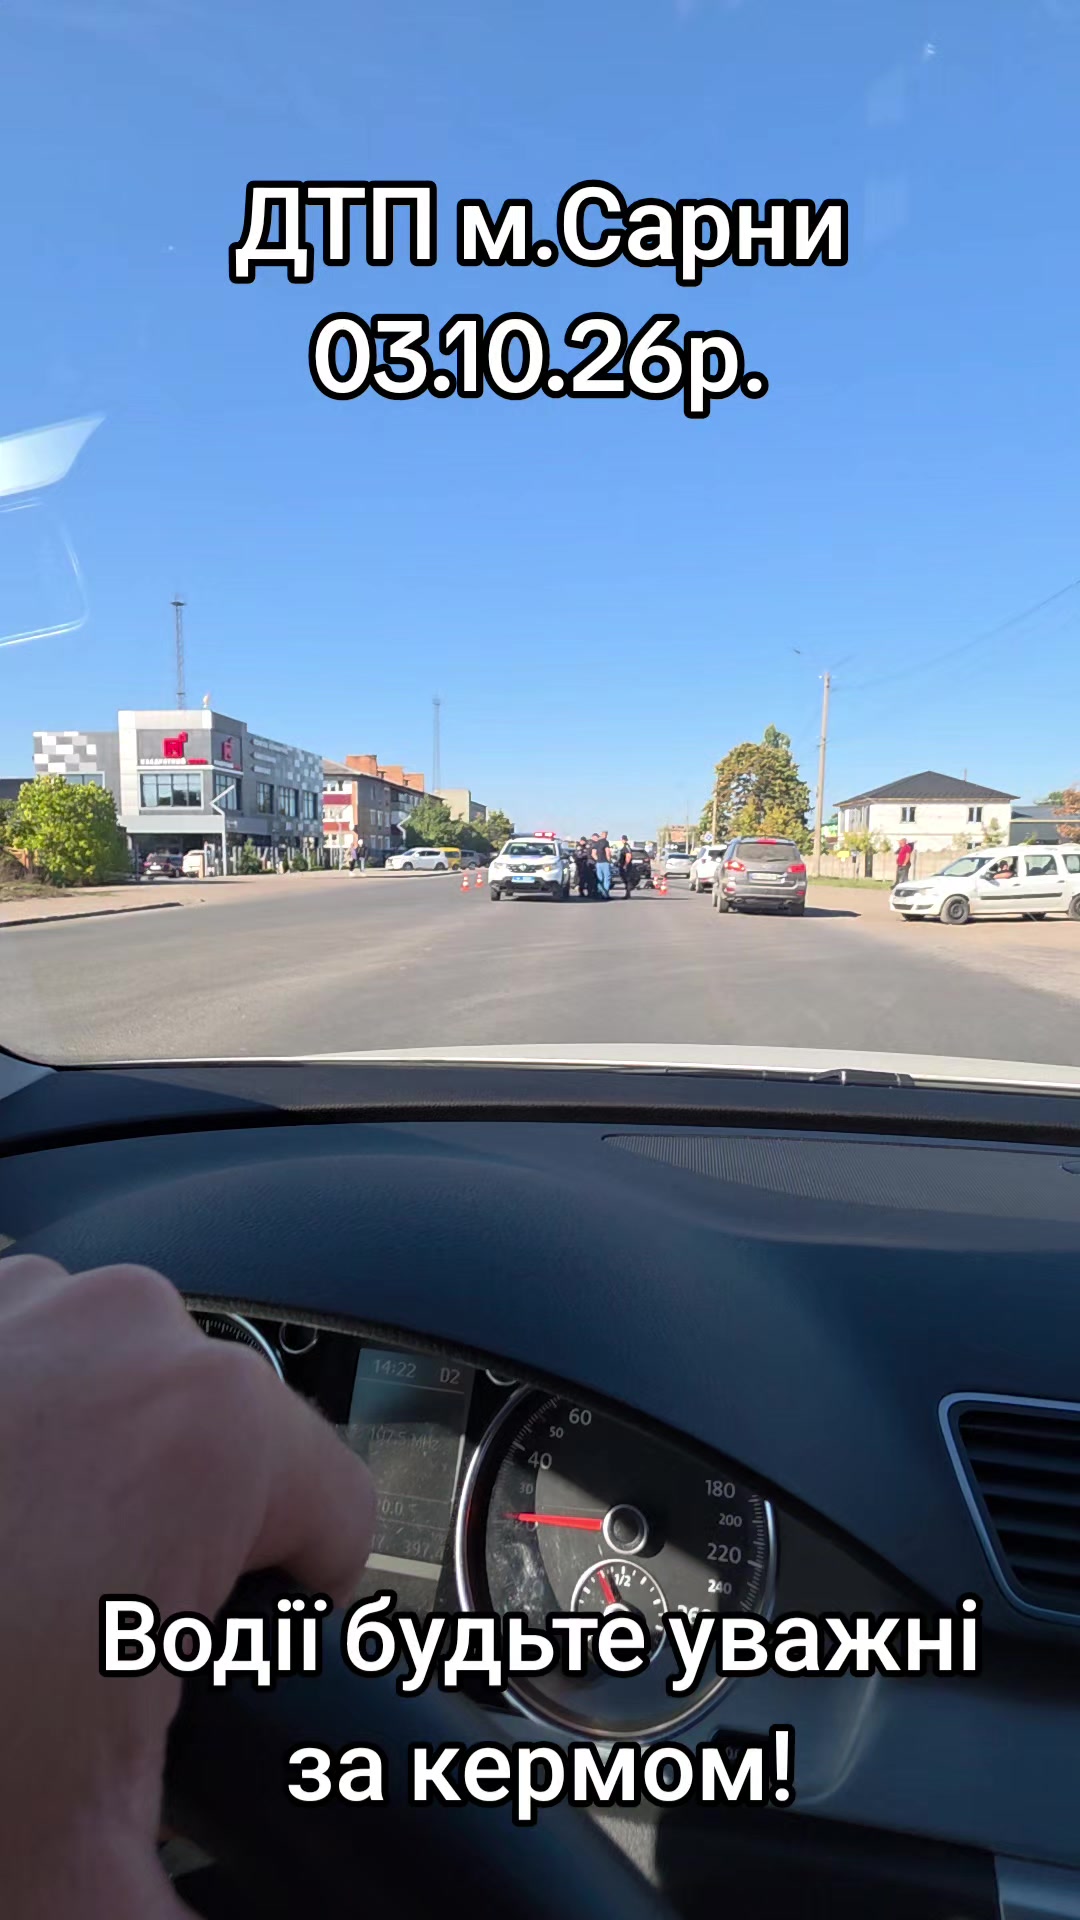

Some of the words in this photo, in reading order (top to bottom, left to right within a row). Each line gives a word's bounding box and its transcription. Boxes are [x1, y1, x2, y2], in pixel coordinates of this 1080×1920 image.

[375, 1359, 416, 1378] 14:22
[568, 1407, 593, 1427] 60
[548, 1425, 565, 1439] 50
[527, 1451, 553, 1471] 40
[704, 1479, 736, 1500] 180
[718, 1512, 743, 1528] 200
[706, 1543, 742, 1565] 220
[612, 1572, 632, 1589] 1/2
[707, 1578, 733, 1595] 240
